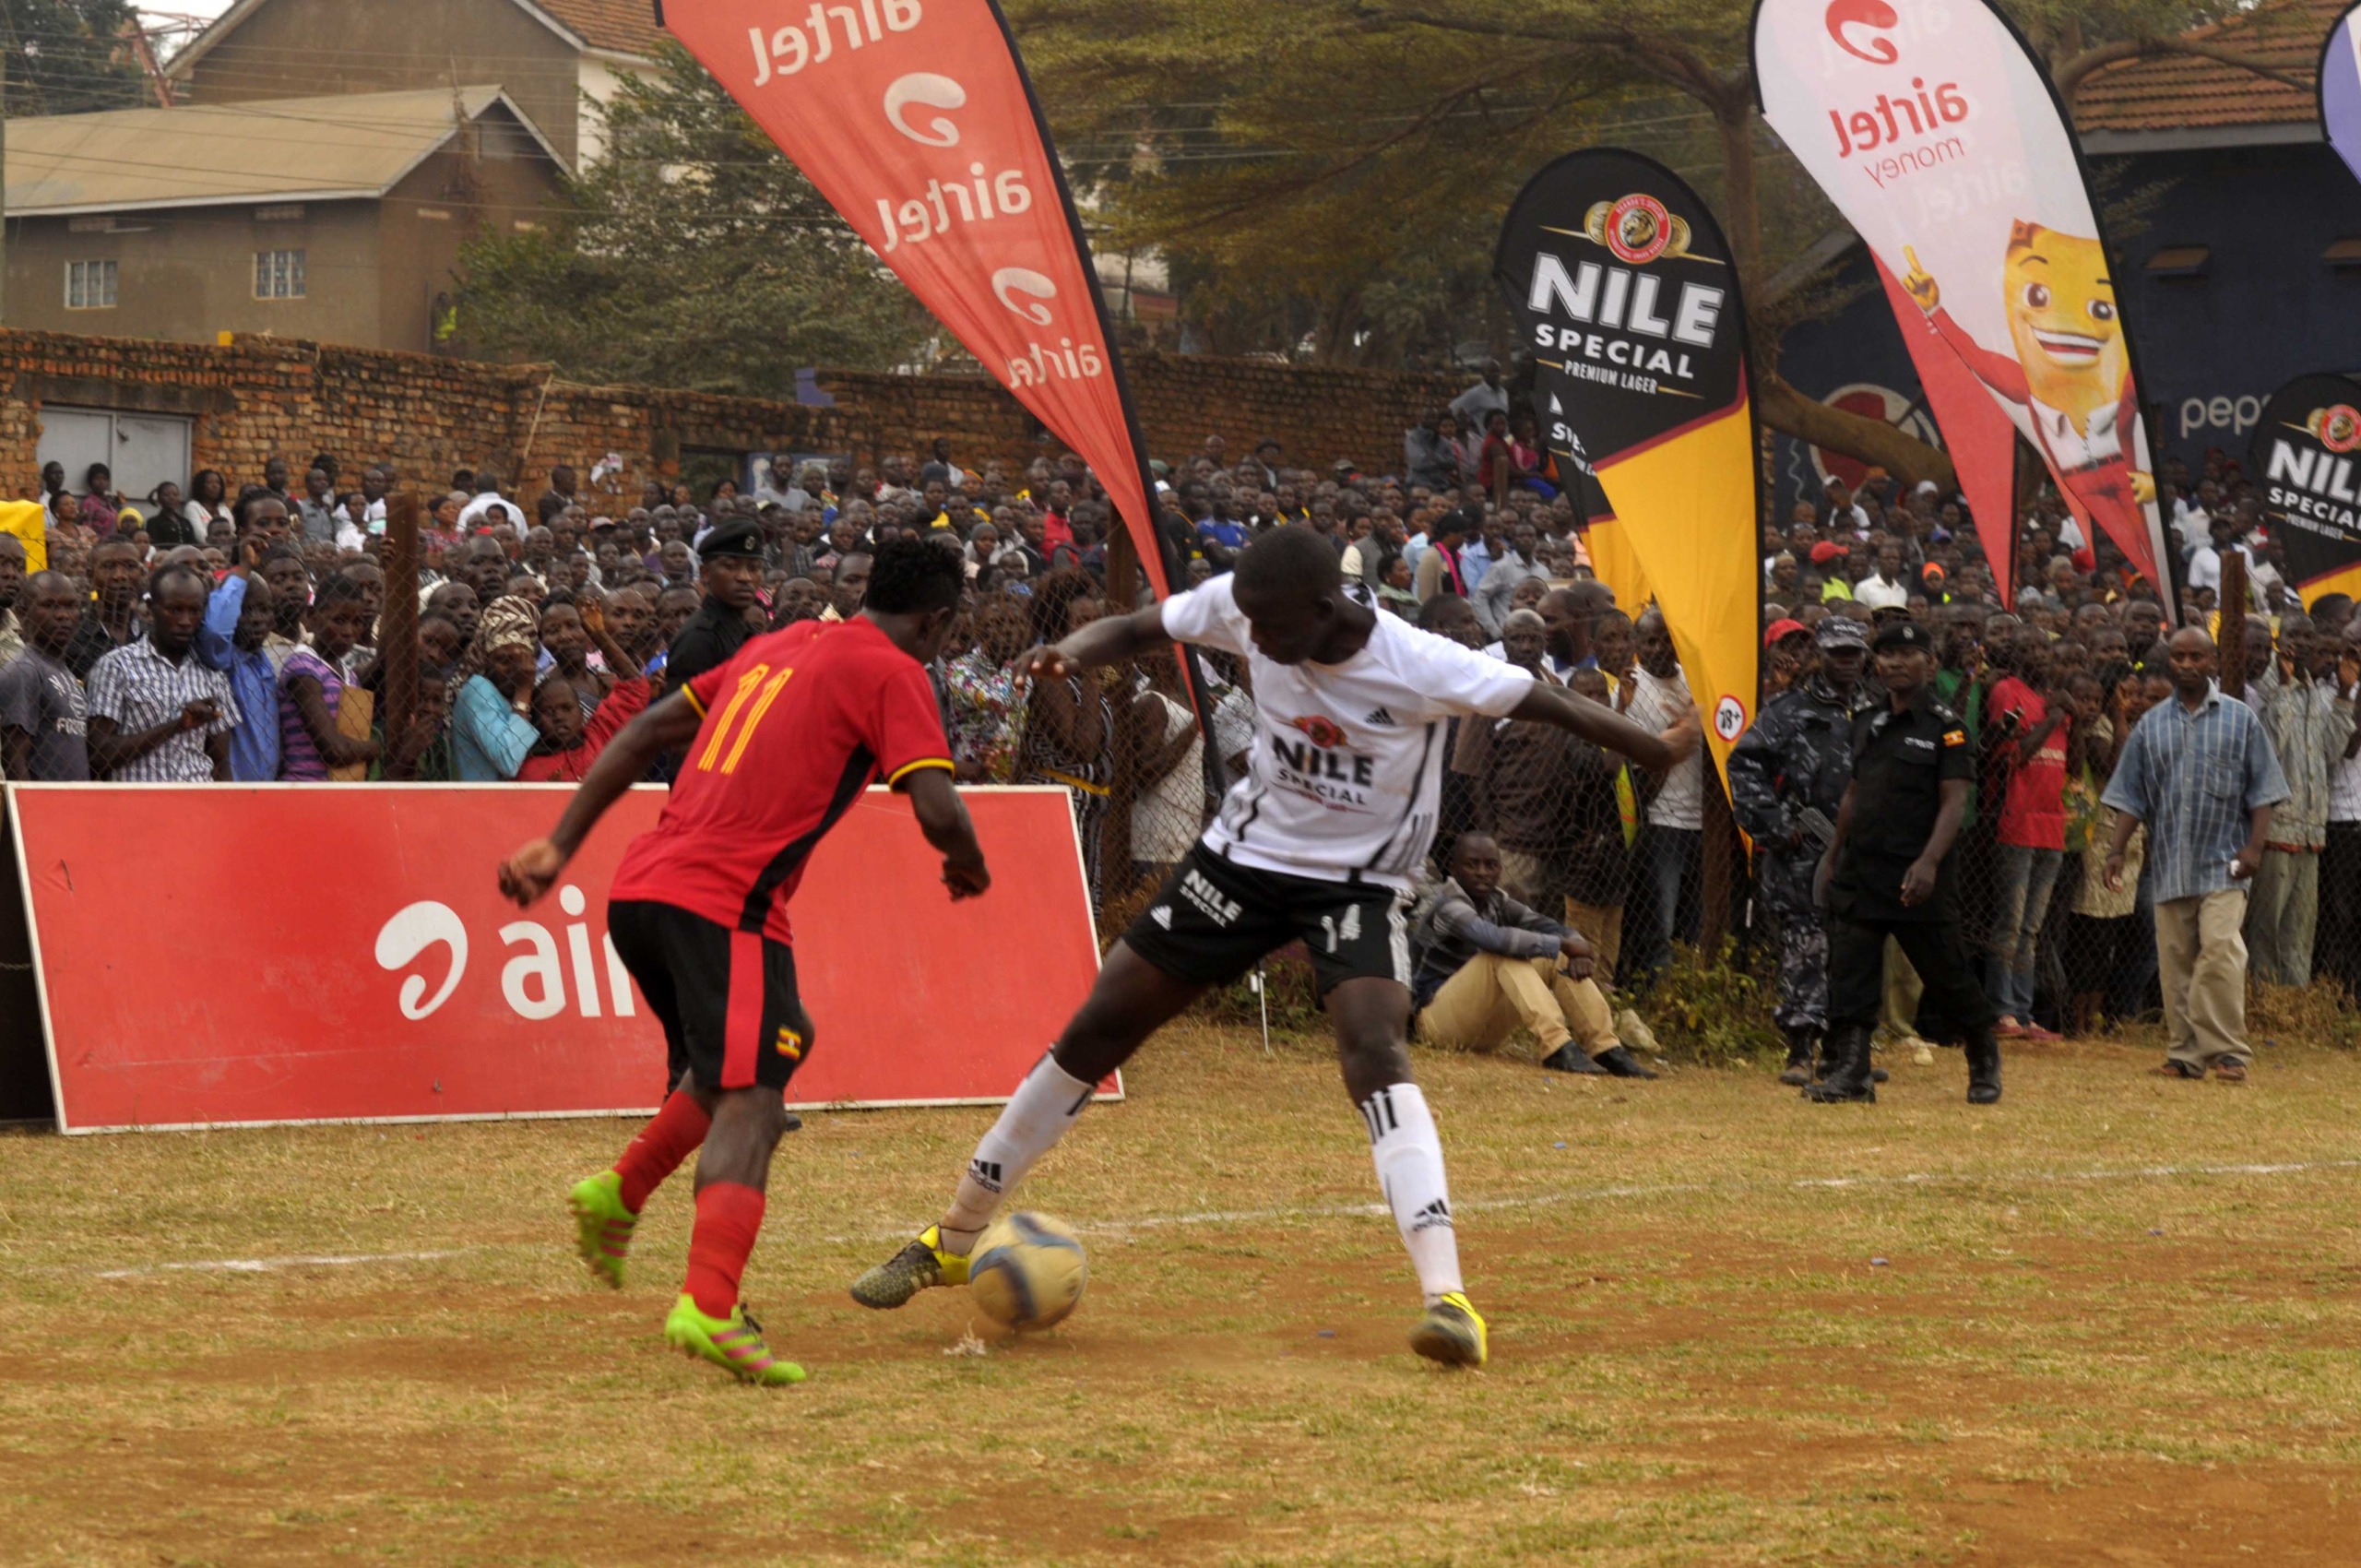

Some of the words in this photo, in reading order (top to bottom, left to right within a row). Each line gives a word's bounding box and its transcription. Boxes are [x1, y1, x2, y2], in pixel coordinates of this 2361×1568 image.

[1527, 251, 1725, 349] NILE
[1535, 323, 1694, 379] SPECIAL
[1565, 359, 1618, 386] PREMIUM
[1620, 372, 1657, 395] LAGER
[2180, 394, 2272, 440] pep
[2267, 437, 2361, 508] NIL
[697, 662, 793, 775] 11
[1272, 734, 1373, 789] NILE
[1277, 767, 1367, 807] SPECIAL
[1184, 868, 1243, 922] NILE
